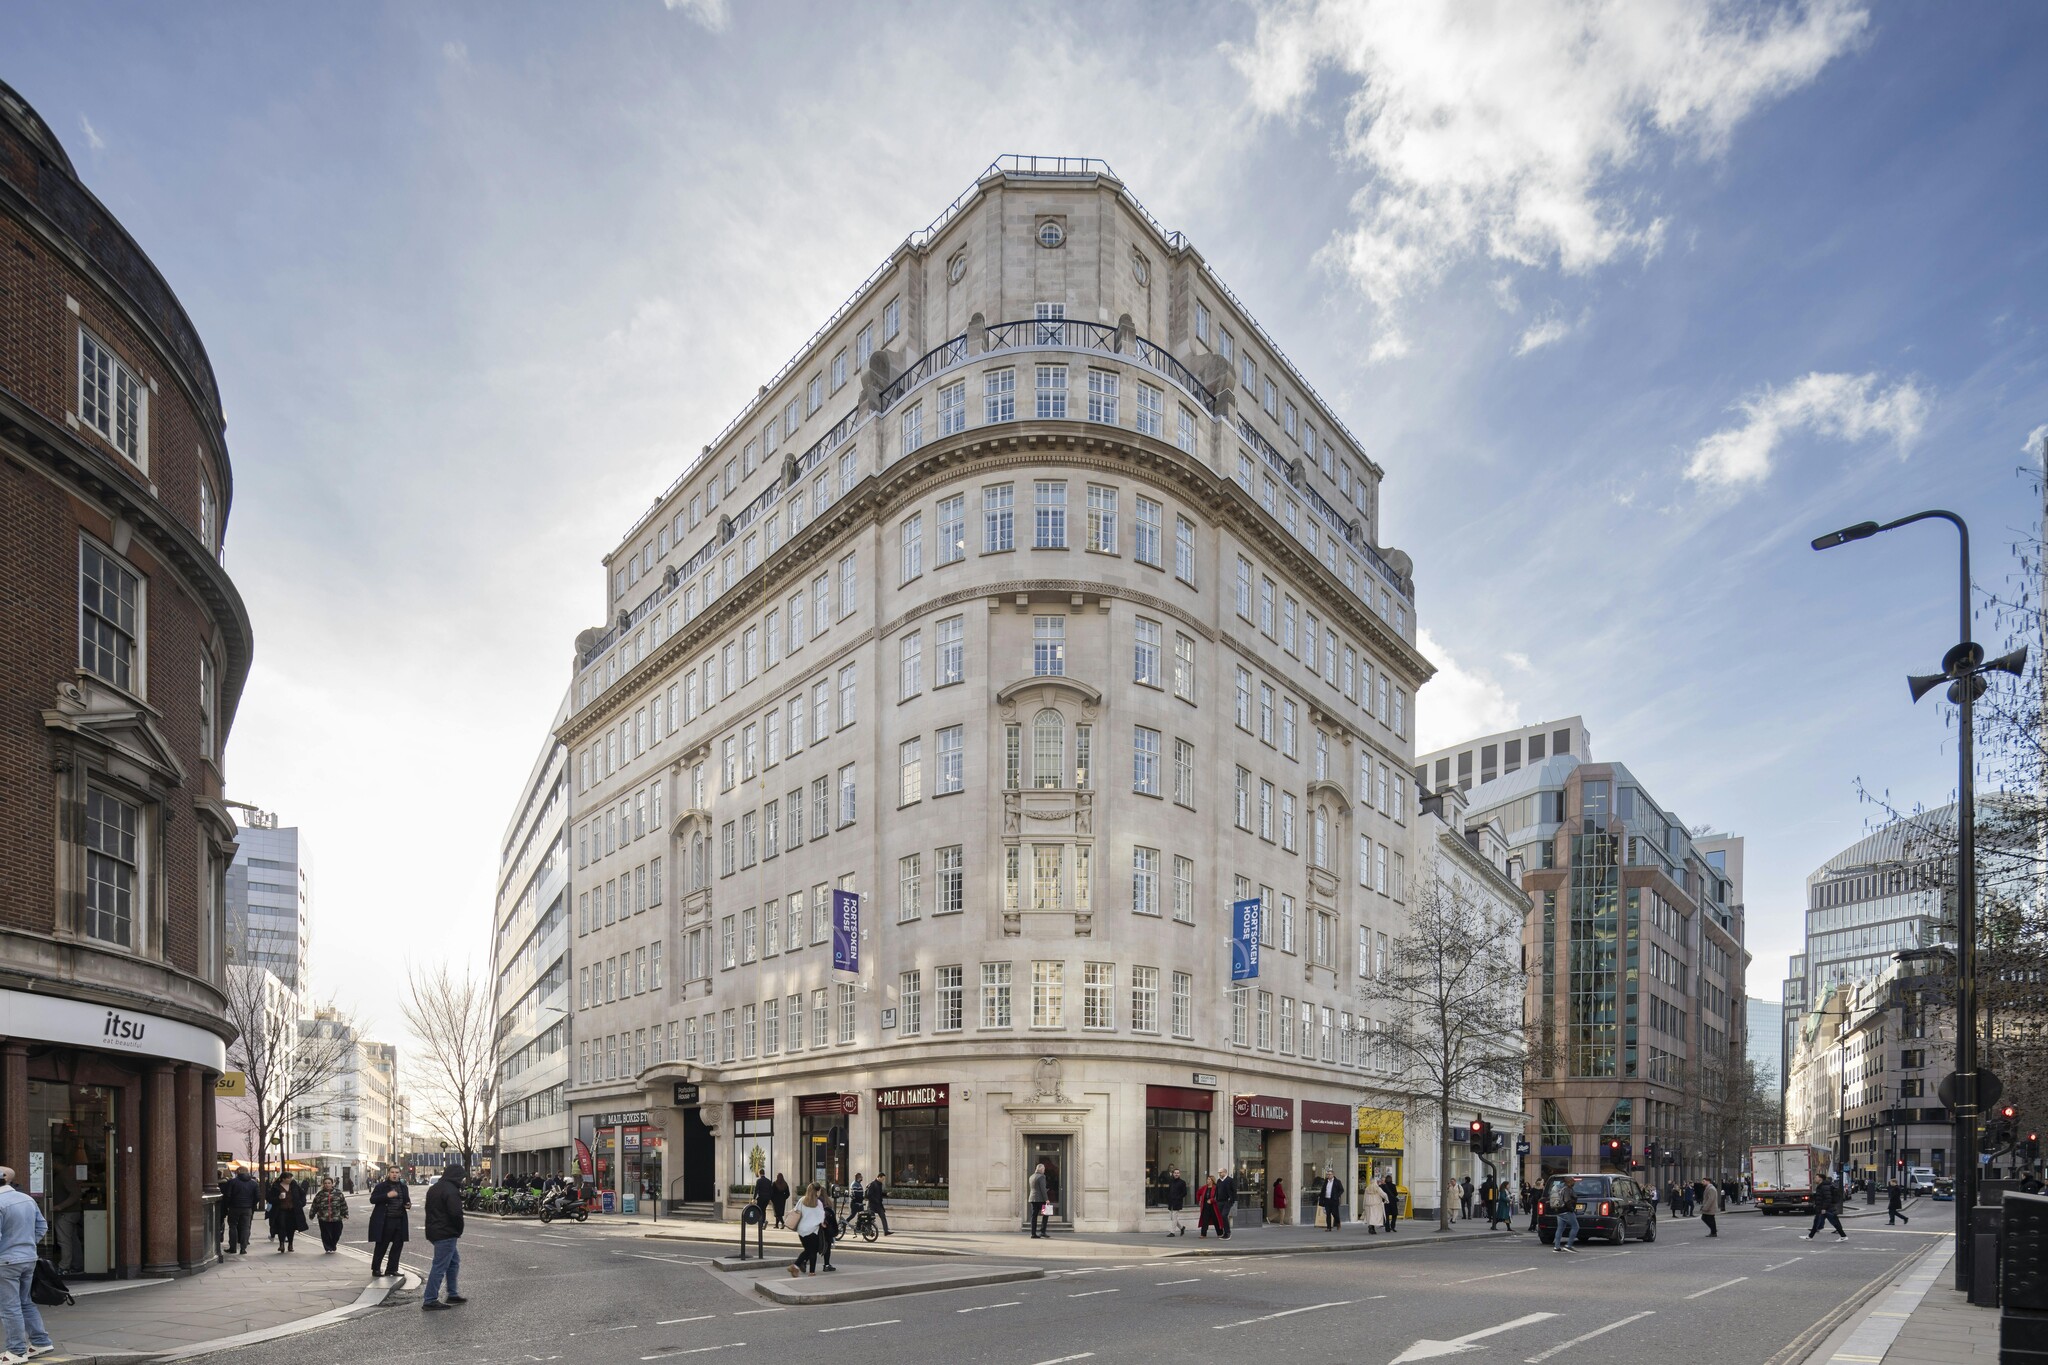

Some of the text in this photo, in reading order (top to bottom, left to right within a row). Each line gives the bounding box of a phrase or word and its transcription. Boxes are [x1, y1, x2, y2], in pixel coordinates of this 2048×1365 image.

[104, 1011, 145, 1040] itsu
[115, 1038, 142, 1048] beautiful
[884, 1088, 936, 1105] PRET A MANGER
[1261, 1105, 1264, 1118] A
[608, 1114, 622, 1124] MAIL
[623, 1113, 640, 1123] BOXES
[625, 1136, 637, 1144] FedEx
